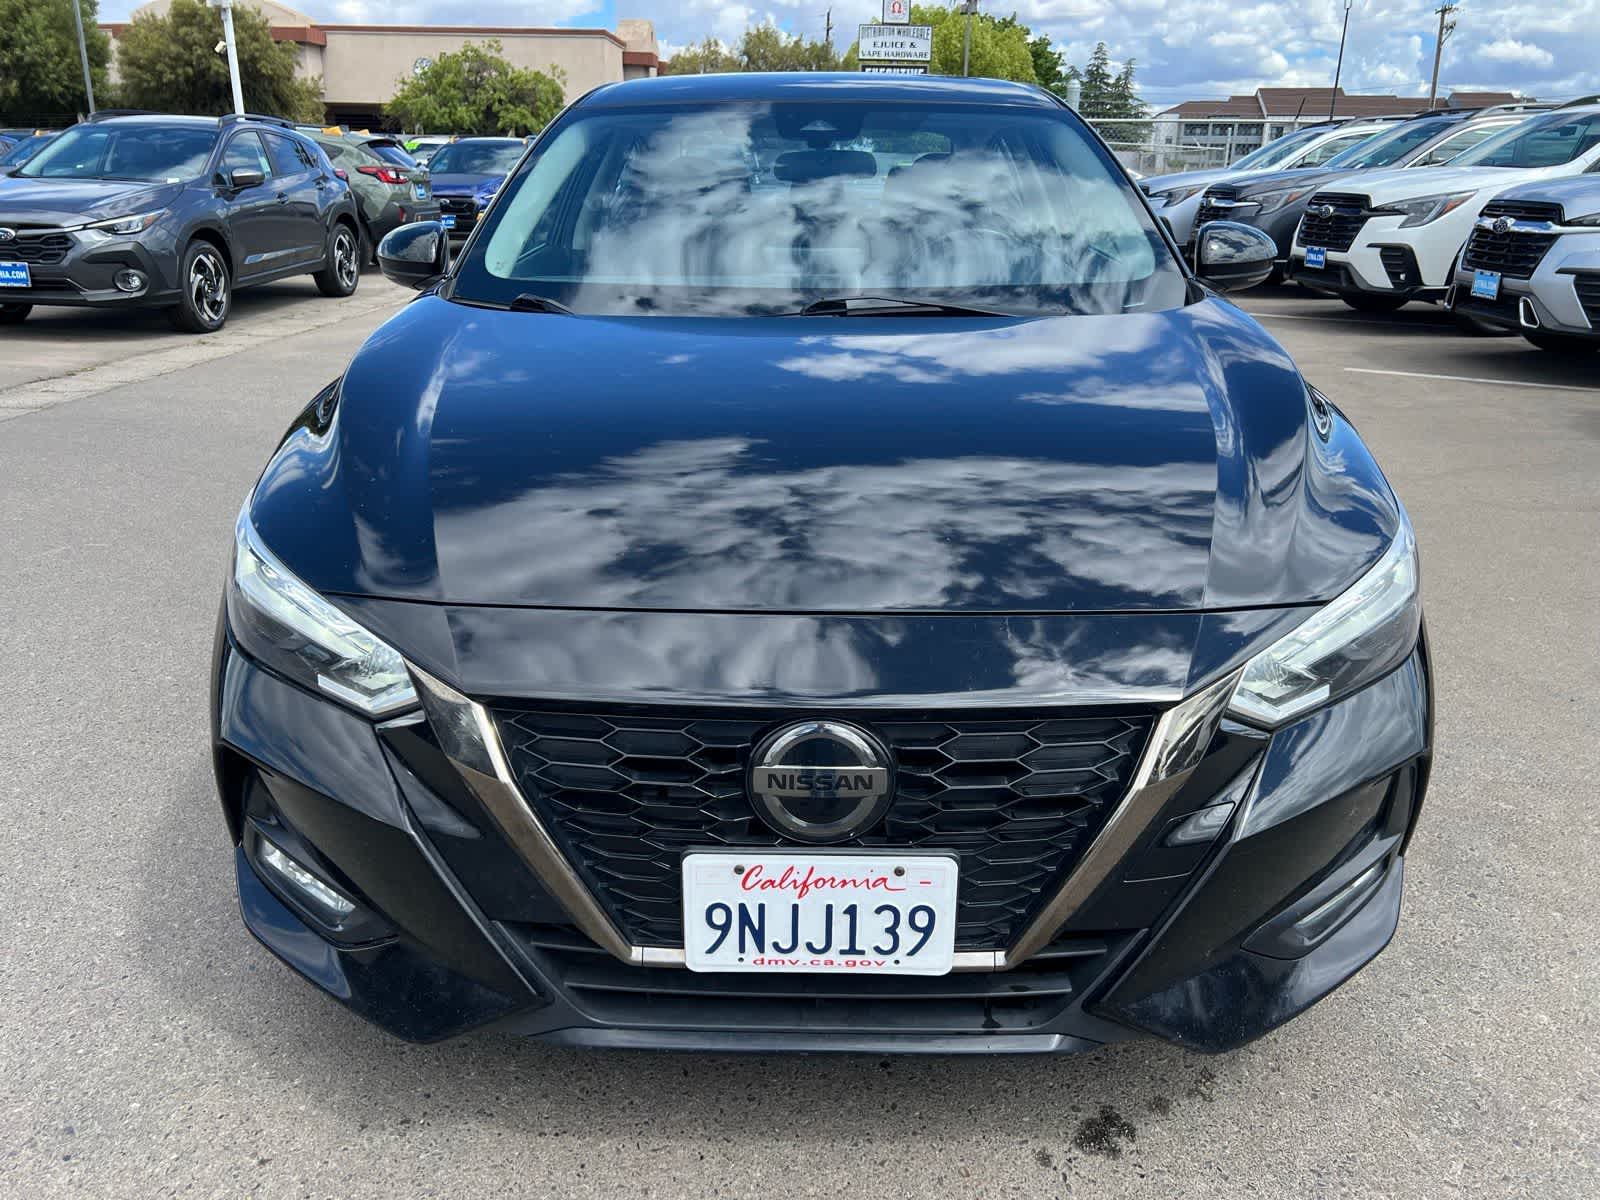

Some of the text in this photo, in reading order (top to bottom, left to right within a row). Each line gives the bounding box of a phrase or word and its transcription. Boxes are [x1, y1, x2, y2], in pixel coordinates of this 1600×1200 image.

[884, 50, 929, 58] HARDWARE
[767, 773, 874, 791] NISSAN
[741, 864, 906, 899] California
[704, 902, 936, 957] 9NJJ139
[753, 957, 886, 968] dmv.ca.gov
